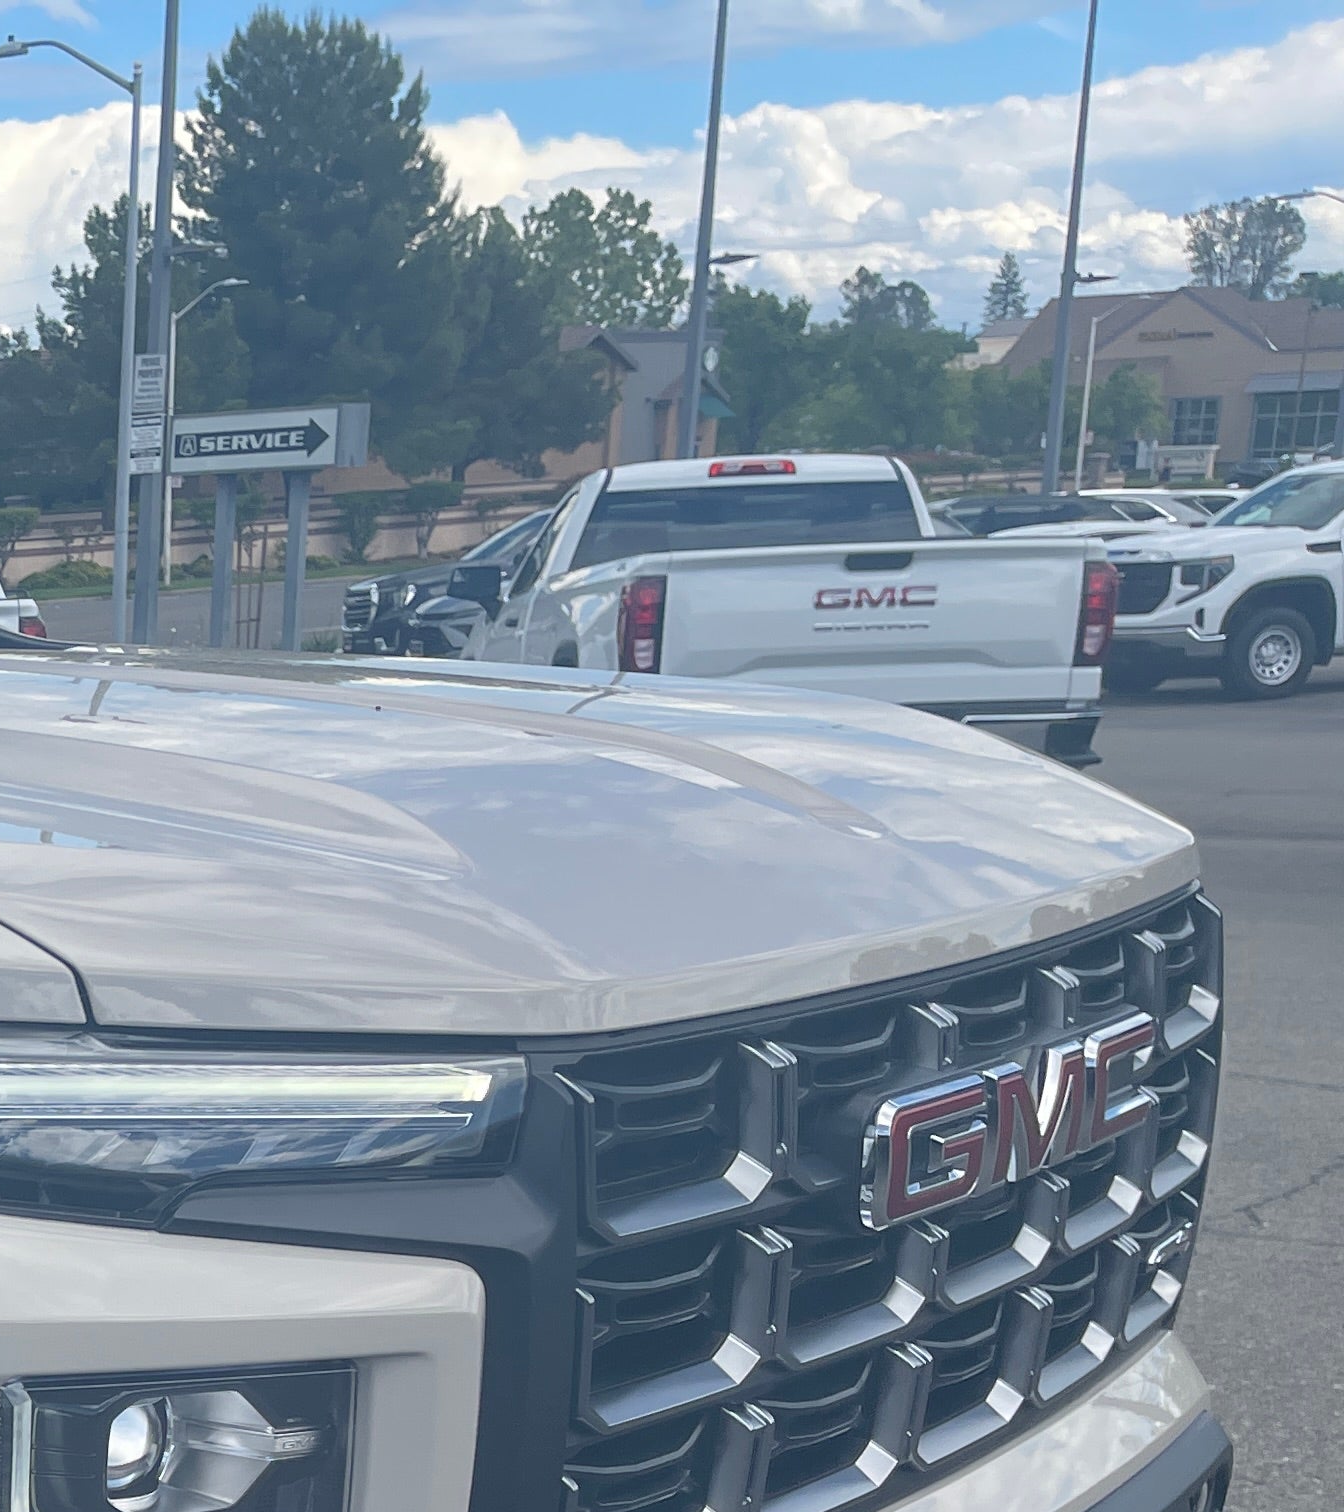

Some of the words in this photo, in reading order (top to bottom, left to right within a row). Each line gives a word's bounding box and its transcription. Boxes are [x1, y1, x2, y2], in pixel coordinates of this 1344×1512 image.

[199, 430, 306, 453] SERVICE
[814, 585, 938, 610] GMC
[864, 1012, 1158, 1230] GMC
